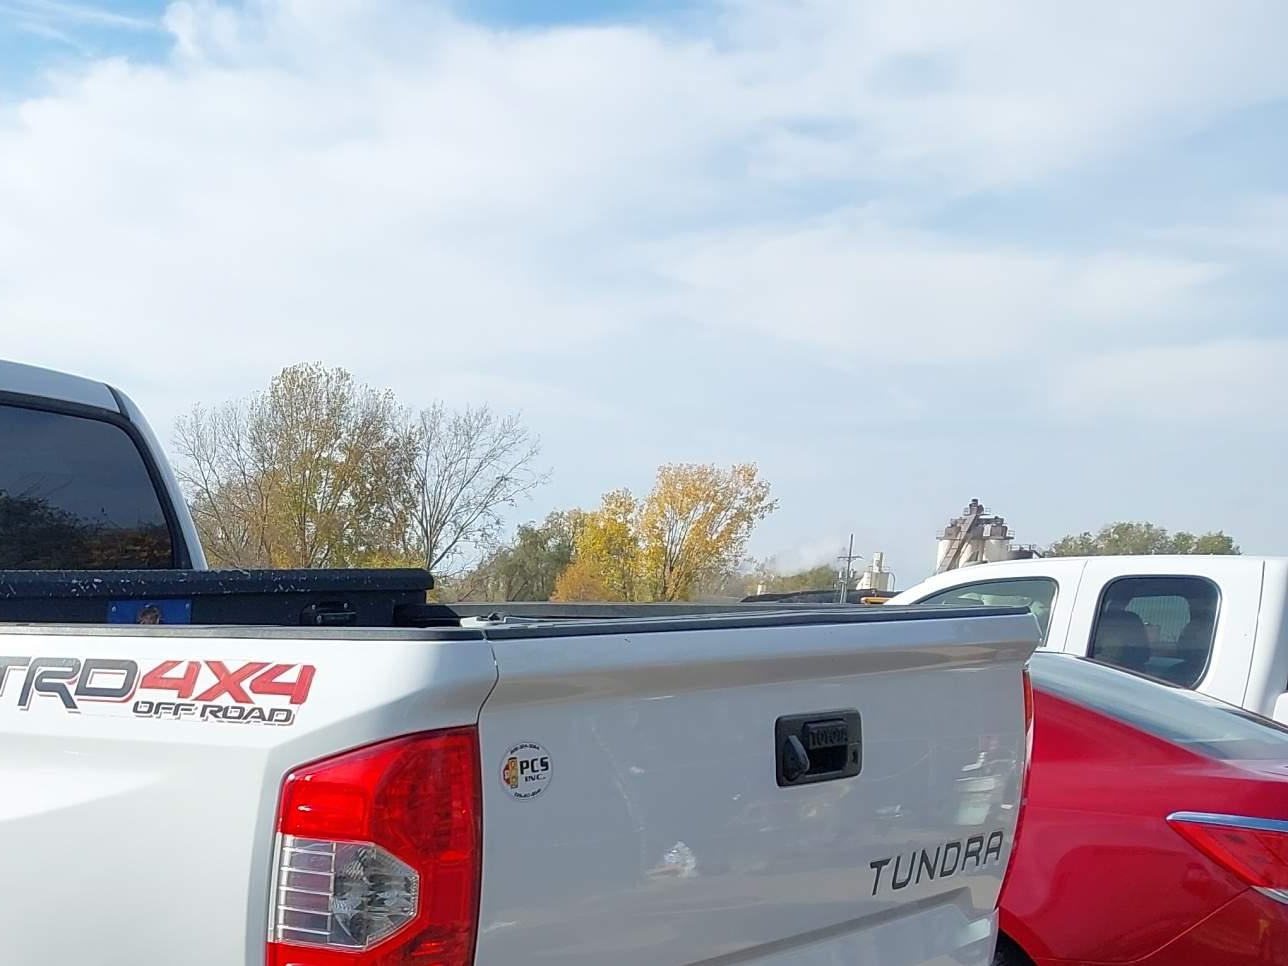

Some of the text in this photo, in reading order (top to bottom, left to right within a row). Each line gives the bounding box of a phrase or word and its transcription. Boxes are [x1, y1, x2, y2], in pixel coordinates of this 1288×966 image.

[140, 659, 316, 705] 4X4
[132, 700, 298, 727] OFF ROAD
[519, 756, 550, 775] PCS
[869, 830, 1004, 896] TUNDRA
